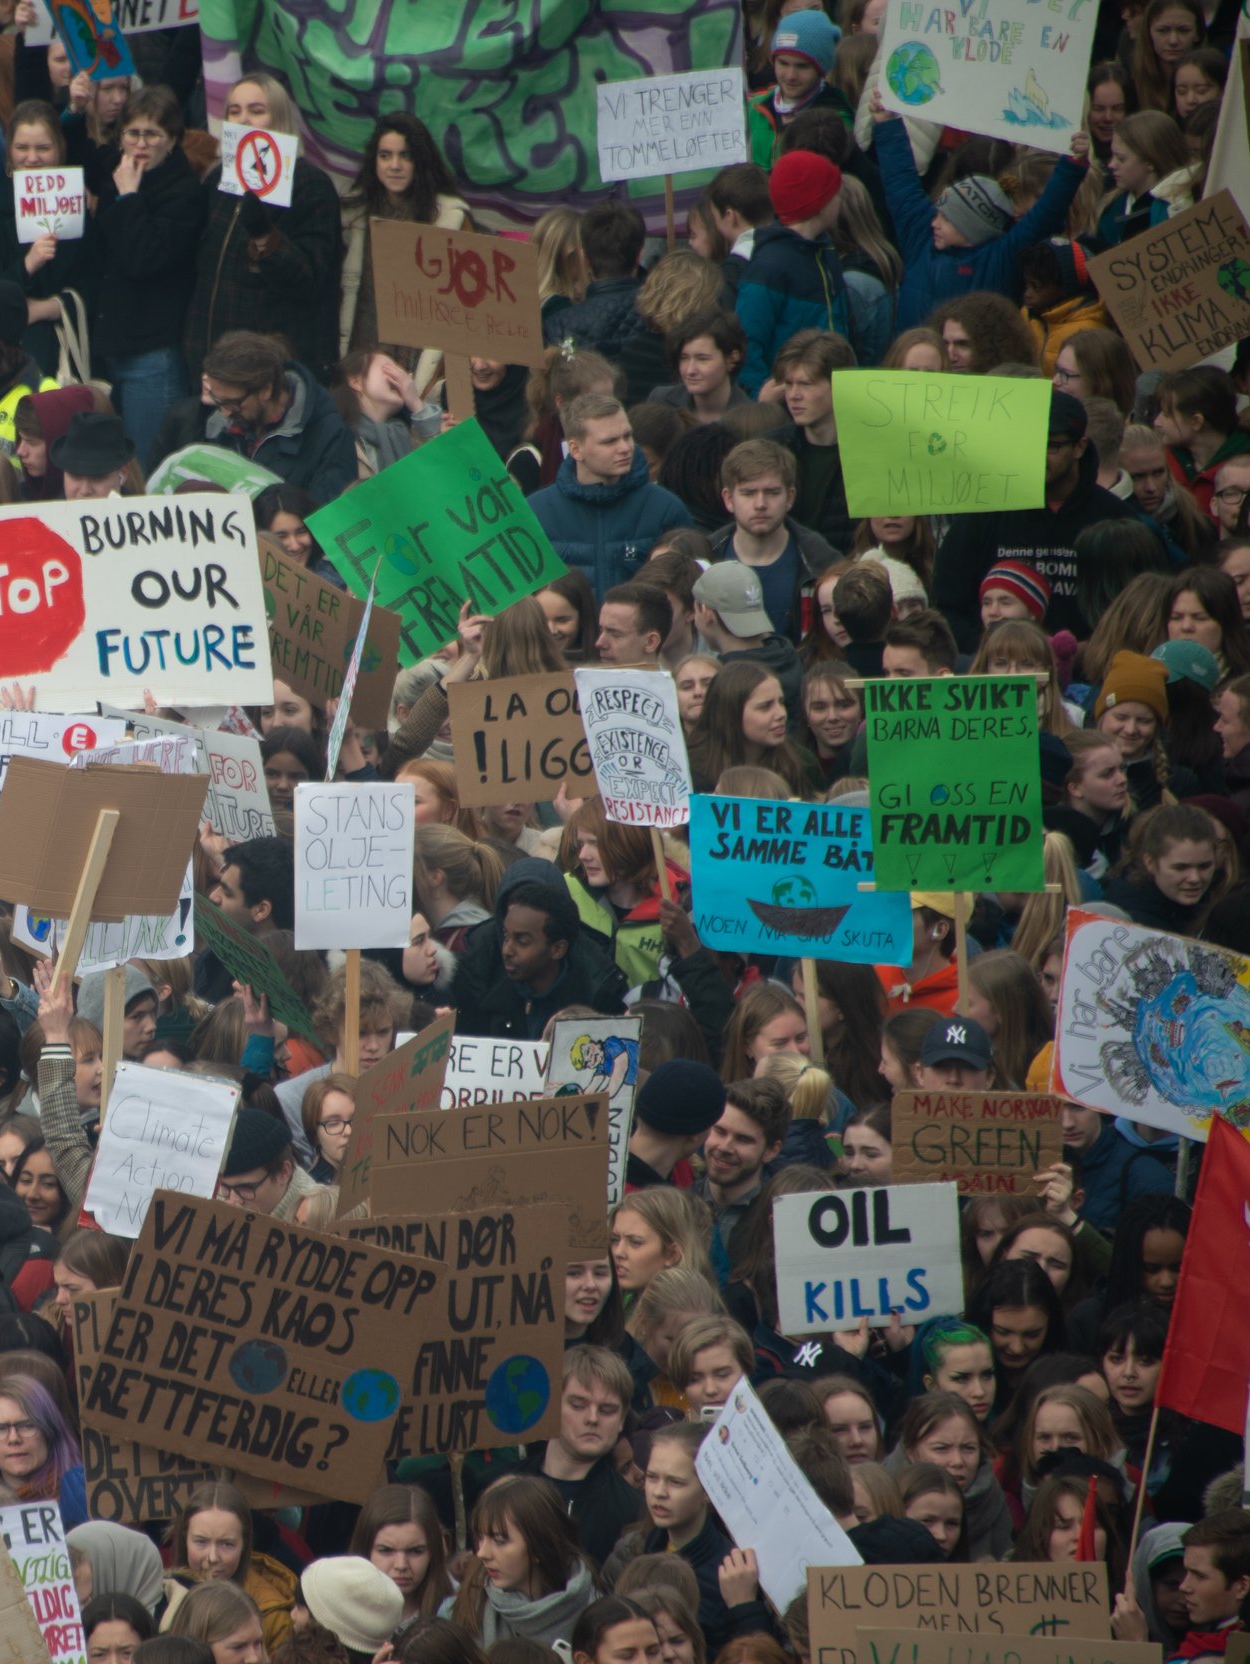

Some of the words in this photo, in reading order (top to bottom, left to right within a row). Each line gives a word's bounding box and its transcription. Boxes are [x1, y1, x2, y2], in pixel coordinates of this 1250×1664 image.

[899, 2, 956, 35] HAR
[968, 15, 1025, 45] BARE
[1040, 26, 1071, 53] EN
[950, 36, 1015, 65] KLODE
[605, 92, 627, 121] VI
[634, 79, 737, 117] TRENGER
[632, 115, 674, 137] MER
[680, 110, 713, 131] ENN
[602, 129, 747, 172] TOMMELØFTER
[24, 175, 66, 194] REDD
[20, 195, 83, 218] MILJØET
[1151, 281, 1202, 318] IKKE
[1139, 297, 1232, 364] KLIMA
[860, 379, 1015, 428] STREIK
[886, 467, 1019, 507] MILJØET
[80, 505, 246, 555] BURNING
[131, 563, 241, 610] OUR
[264, 550, 308, 600] DET
[318, 588, 341, 619] ER
[287, 604, 324, 645] VÅR
[95, 624, 255, 677] FUTURE
[483, 692, 527, 722] LA
[594, 690, 662, 718] RESPECT
[869, 683, 932, 712] IKKE
[944, 683, 1030, 711] SVIKT
[598, 729, 668, 763] EXISTENCE
[873, 716, 941, 742] BARNA
[950, 715, 1033, 741] DERES,
[210, 753, 258, 793] FOR
[618, 755, 642, 769] OR
[608, 776, 676, 805] EXPECT
[878, 783, 910, 809] GI
[930, 782, 976, 806] OSS
[989, 781, 1029, 805] EN
[306, 793, 405, 836] STANS
[710, 802, 740, 831] VI
[756, 806, 792, 835] ER
[803, 810, 863, 838] ALLE
[879, 813, 1032, 846] FRAMTID
[305, 835, 407, 871] OLJE-
[709, 832, 808, 866] SAMME
[305, 874, 407, 911] LETING
[699, 914, 748, 935] NOEN
[841, 931, 895, 948] SKUTA
[1075, 926, 1142, 985] bare
[1065, 989, 1097, 1041] har
[491, 1045, 524, 1079] ER
[1069, 1062, 1105, 1097] Vi
[110, 1094, 215, 1159] Climate
[913, 1095, 974, 1119] MAKE
[981, 1099, 1062, 1121] NORWAY
[386, 1120, 447, 1160] NOK
[462, 1114, 506, 1150] ER
[518, 1102, 600, 1143] NOK!
[911, 1124, 1041, 1171] GREEN
[112, 1153, 195, 1192] Action
[808, 1189, 911, 1248] OIL
[153, 1200, 197, 1255] VI
[197, 1213, 255, 1271] MÅ
[254, 1227, 367, 1300] RYDDE
[360, 1259, 437, 1315] OPP
[456, 1212, 516, 1271] DØR
[121, 1253, 144, 1300] I
[145, 1257, 256, 1329] DERES
[259, 1286, 361, 1356] KAOS
[510, 1256, 556, 1326] NÅ
[804, 1268, 931, 1323] KILLS
[103, 1307, 154, 1364] ER
[158, 1319, 236, 1382] DET
[286, 1367, 341, 1407] ELLER
[412, 1336, 496, 1397] FINNE
[20, 1506, 62, 1545] ER
[819, 1572, 959, 1609] KLODEN
[976, 1571, 1101, 1608] BRENNER
